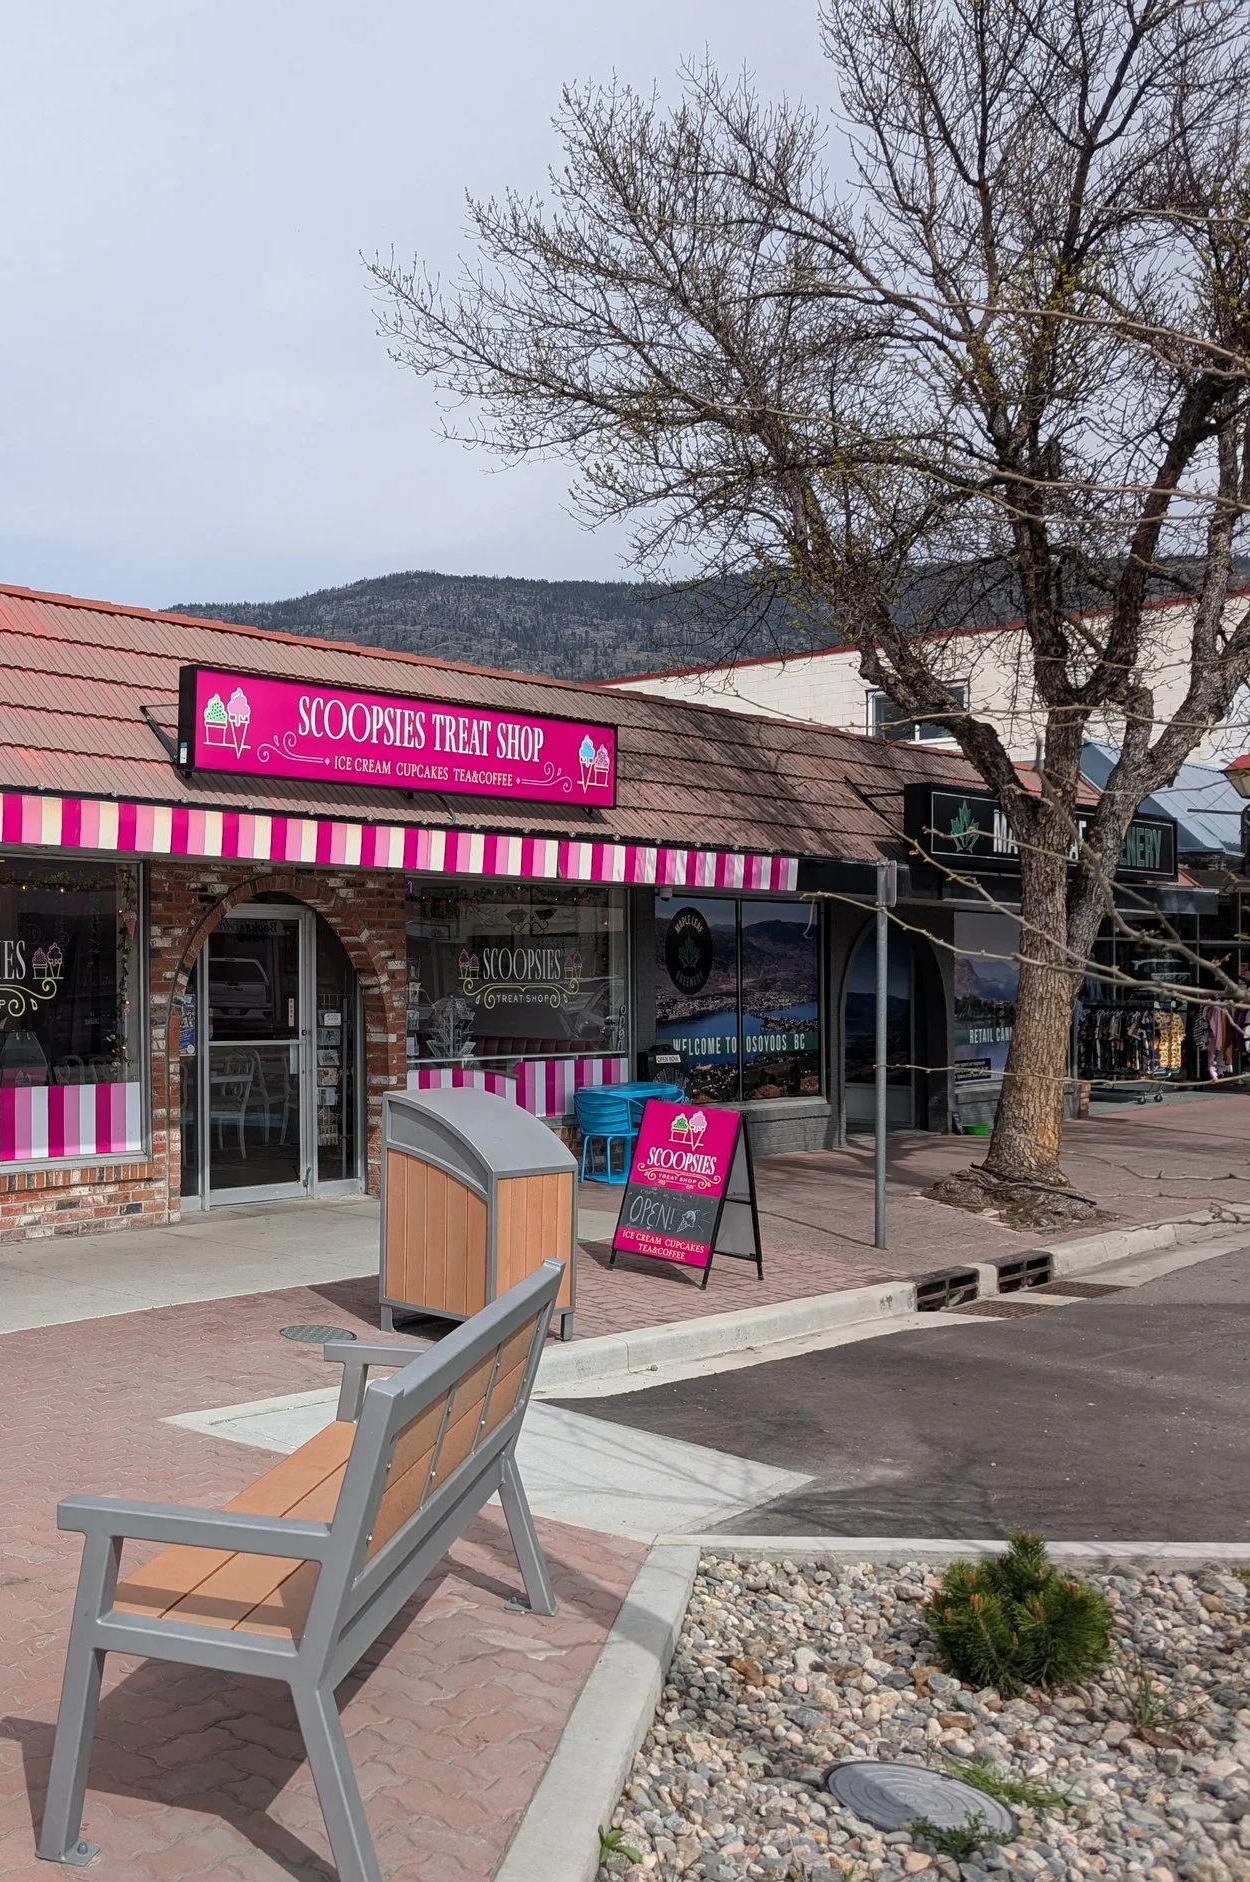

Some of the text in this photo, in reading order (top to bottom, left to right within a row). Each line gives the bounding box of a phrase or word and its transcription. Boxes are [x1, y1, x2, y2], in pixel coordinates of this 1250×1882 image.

[298, 696, 544, 762] SCOOPSIES TREAT SHOP
[334, 755, 513, 787] ICE CREAM CUPCAKES TEA&COFFEE
[674, 914, 705, 935] MAPLE LEAF
[483, 948, 561, 980] SCOOPSIES
[497, 994, 549, 1003] TREAT SHOP
[673, 1033, 806, 1056] WELCOME TO OSOYOOS BC
[969, 1028, 994, 1044] RETAIL
[647, 1147, 717, 1175] SCOOPSIES
[658, 1173, 698, 1184] TREAT SHOP
[622, 1230, 704, 1254] ICE CREAM CUPCAKES
[638, 1243, 686, 1260] TEA&COFFEE
